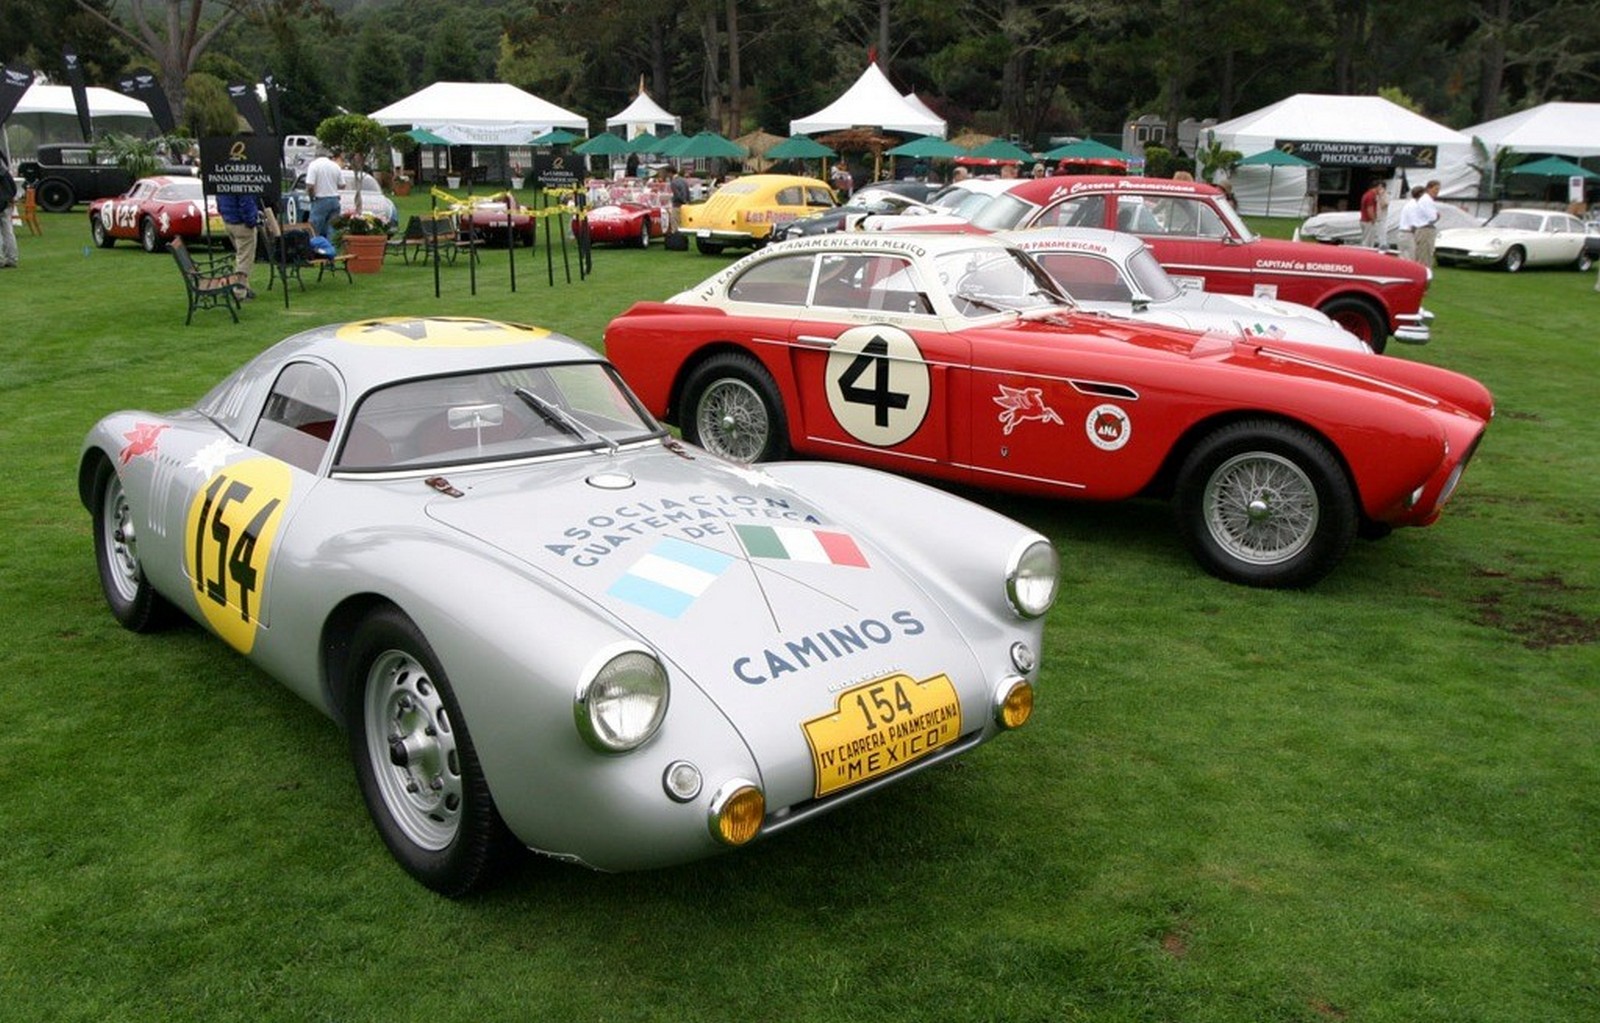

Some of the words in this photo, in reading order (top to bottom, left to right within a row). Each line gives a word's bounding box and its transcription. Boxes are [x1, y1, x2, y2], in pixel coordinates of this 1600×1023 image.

[1300, 144, 1365, 154] AUTOMOTIVE
[1368, 145, 1390, 154] FINE
[1394, 147, 1413, 155] ART
[1321, 153, 1394, 164] PHOTOGRAPHY
[225, 164, 263, 172] CARRERA
[208, 174, 272, 183] PANAMERICANA
[1071, 182, 1116, 193] Carrera
[1118, 180, 1195, 192] Panamericana
[217, 184, 264, 192] EXHIBITION
[778, 237, 879, 252] PANAMERICANA
[882, 240, 926, 258] MEXICO
[1032, 241, 1108, 254] PANAMERICANA
[837, 334, 910, 428] 4
[544, 495, 790, 557] ASOCIACION
[681, 522, 725, 539] DE
[196, 474, 281, 624] 154
[733, 610, 925, 685] CAMINOS
[857, 681, 913, 730] 154
[820, 749, 834, 769] IV
[838, 731, 886, 762] CARRERA
[888, 702, 957, 740] PANAMERICANA
